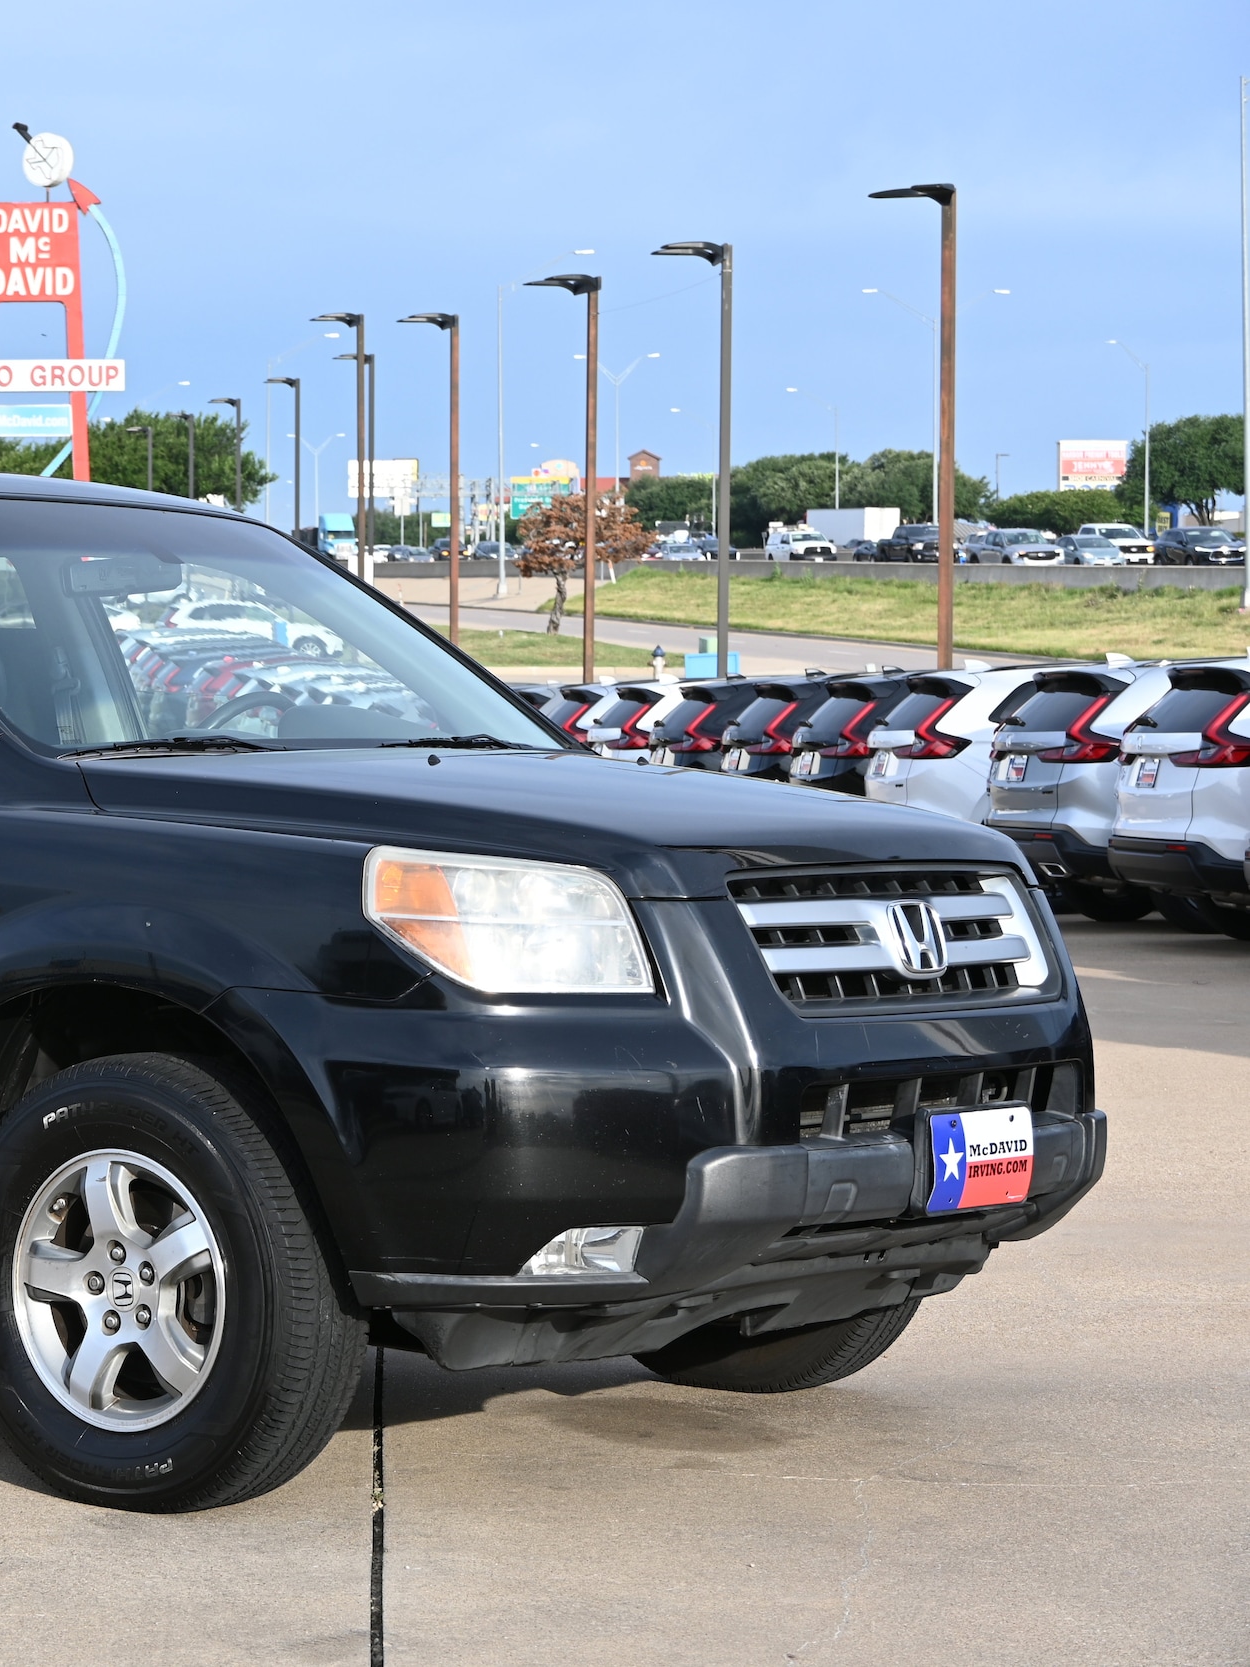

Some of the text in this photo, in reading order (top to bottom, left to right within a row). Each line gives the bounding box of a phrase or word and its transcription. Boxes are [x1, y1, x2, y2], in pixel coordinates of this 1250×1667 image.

[9, 236, 51, 263] Mc
[30, 364, 119, 387] GROUP
[969, 1139, 1028, 1157] McDAVID
[968, 1159, 1028, 1179] IRVING.COM
